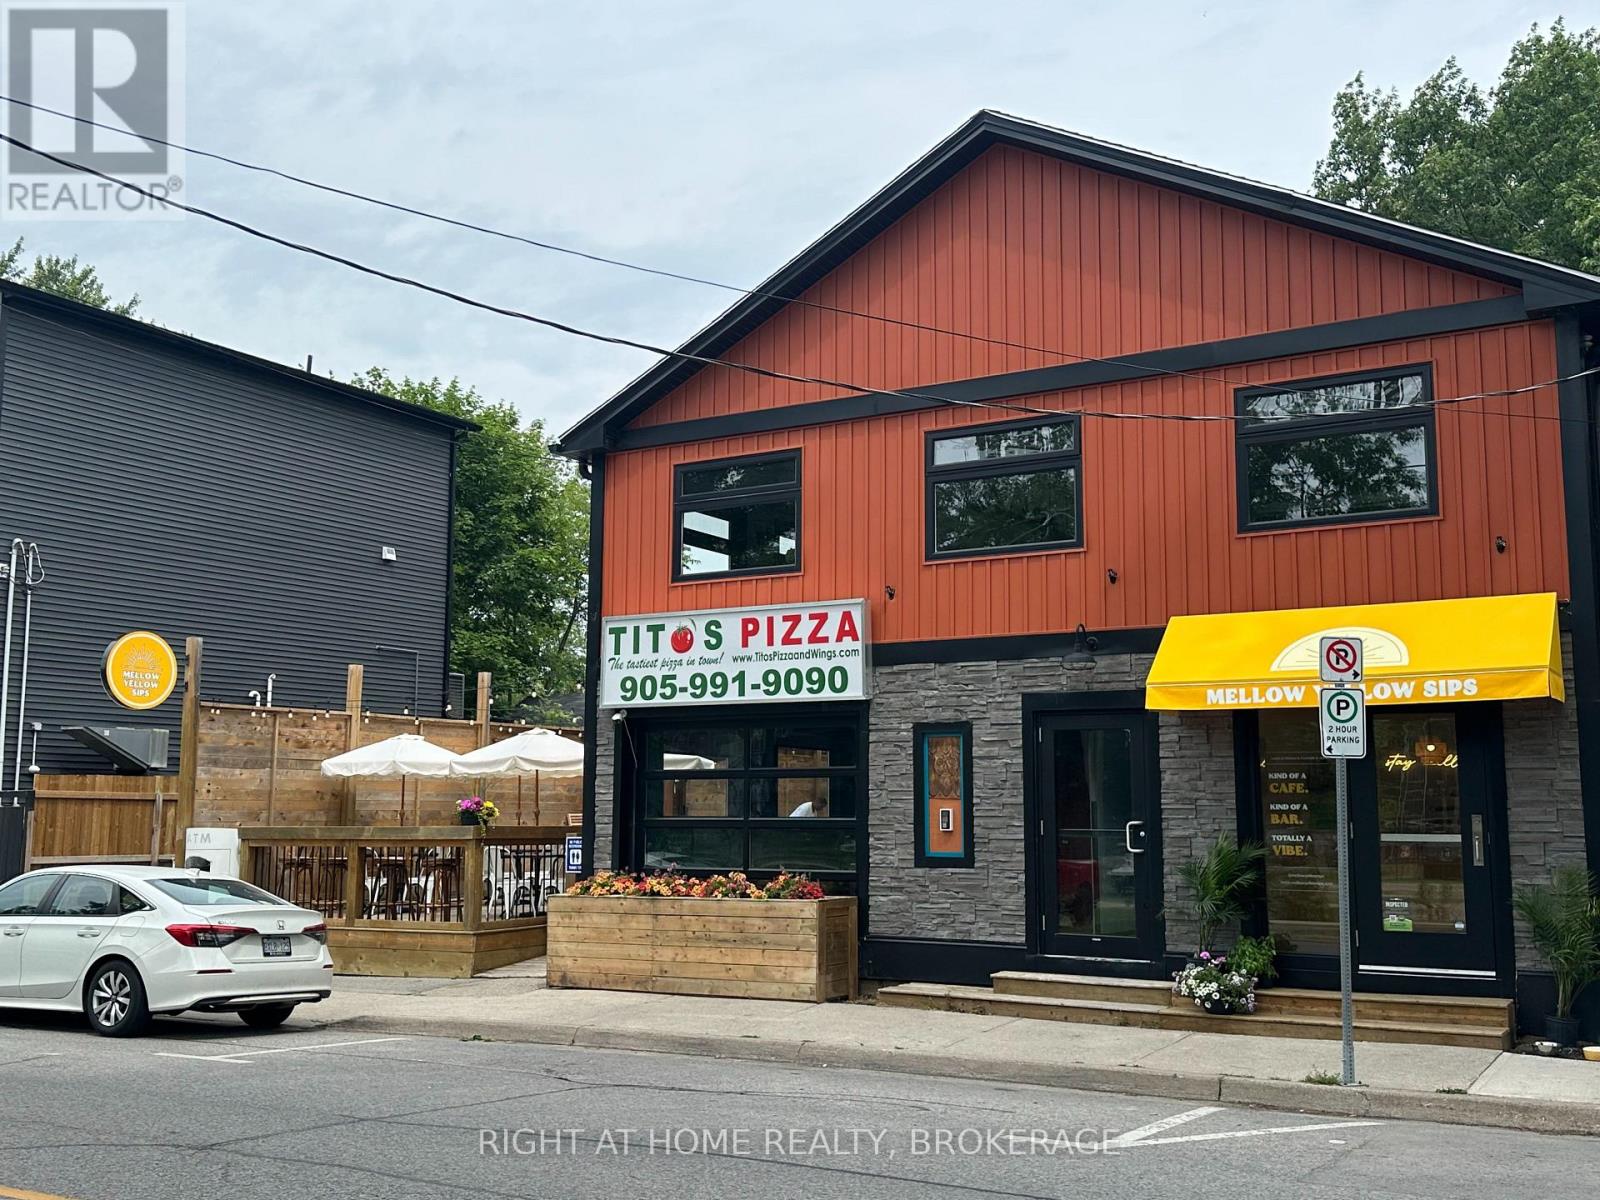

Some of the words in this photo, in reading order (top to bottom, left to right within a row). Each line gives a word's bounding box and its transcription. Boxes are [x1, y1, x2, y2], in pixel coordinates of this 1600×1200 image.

[740, 610, 860, 649] PIZZA
[608, 657, 624, 671] The
[627, 657, 659, 670] tastiest
[660, 657, 683, 671] pizza
[686, 656, 696, 666] in
[698, 652, 725, 666] town!
[731, 647, 860, 664] www.TitosPizzaandWings.com
[123, 670, 160, 681] MELLOW
[124, 680, 159, 690] YELLOW
[619, 664, 850, 701] 905-991-9090
[131, 688, 150, 698] SIPS
[1206, 685, 1306, 705] MELLOW
[1423, 678, 1478, 697] SIPS
[1328, 725, 1335, 733] 2
[1335, 725, 1357, 733] HOUR
[1326, 735, 1360, 744] PARKING
[1384, 752, 1417, 772] stay
[1269, 782, 1309, 794] CAFE.
[1269, 803, 1289, 811] KIND
[1290, 803, 1301, 811] OF
[1302, 803, 1309, 811] A
[1270, 813, 1304, 825] BAR.
[1271, 834, 1305, 842] TOTALLY
[1306, 834, 1313, 842] A
[1272, 844, 1309, 857] VIBE.
